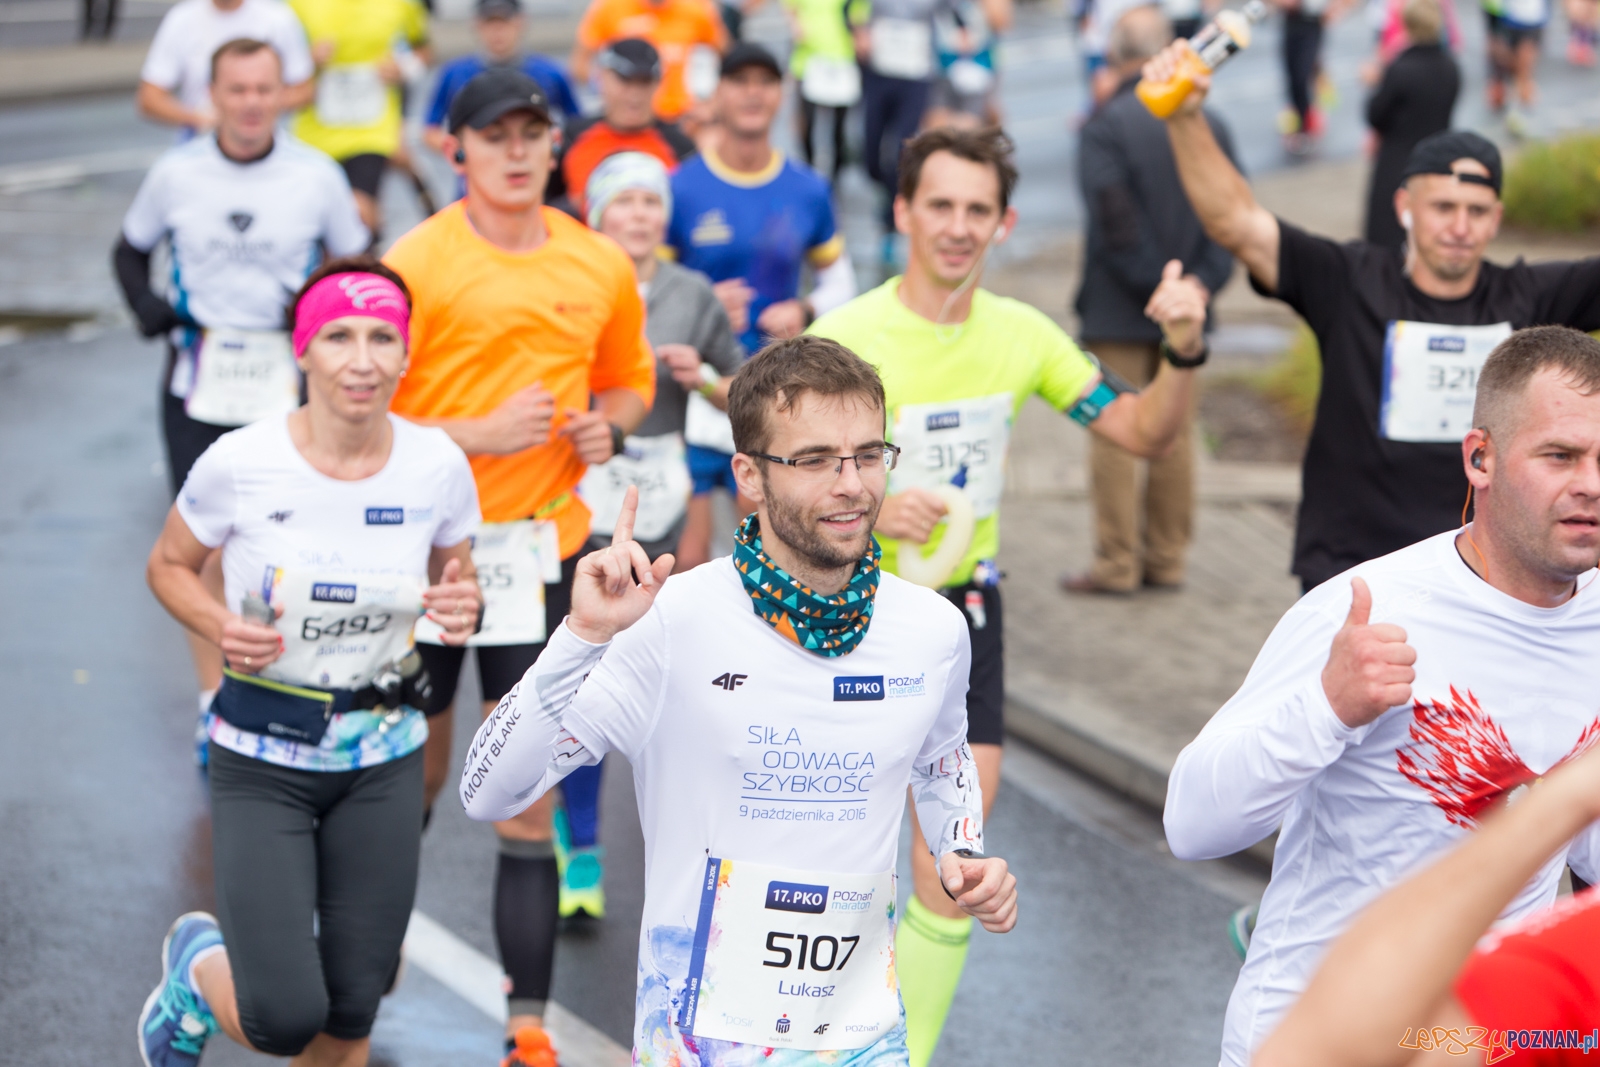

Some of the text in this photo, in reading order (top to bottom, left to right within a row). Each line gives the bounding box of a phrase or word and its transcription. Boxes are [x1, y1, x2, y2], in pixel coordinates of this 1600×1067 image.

[926, 439, 989, 472] 3125
[380, 508, 402, 522] PKO
[329, 585, 355, 601] PKO
[301, 613, 392, 641] 6492
[711, 672, 748, 691] 4F
[855, 682, 881, 694] PKO
[889, 684, 925, 695] maraton
[747, 725, 802, 745] SIŁA
[463, 707, 522, 804] MONT BLANC
[763, 751, 875, 770] ODWAGA
[742, 772, 874, 793] SZYBKOŚĆ
[739, 805, 867, 821] 9 października 2016
[792, 891, 824, 906] PKO
[831, 900, 871, 911] maraton
[763, 931, 861, 972] 5107
[778, 980, 836, 998] Lukasz
[813, 1023, 830, 1035] 4F
